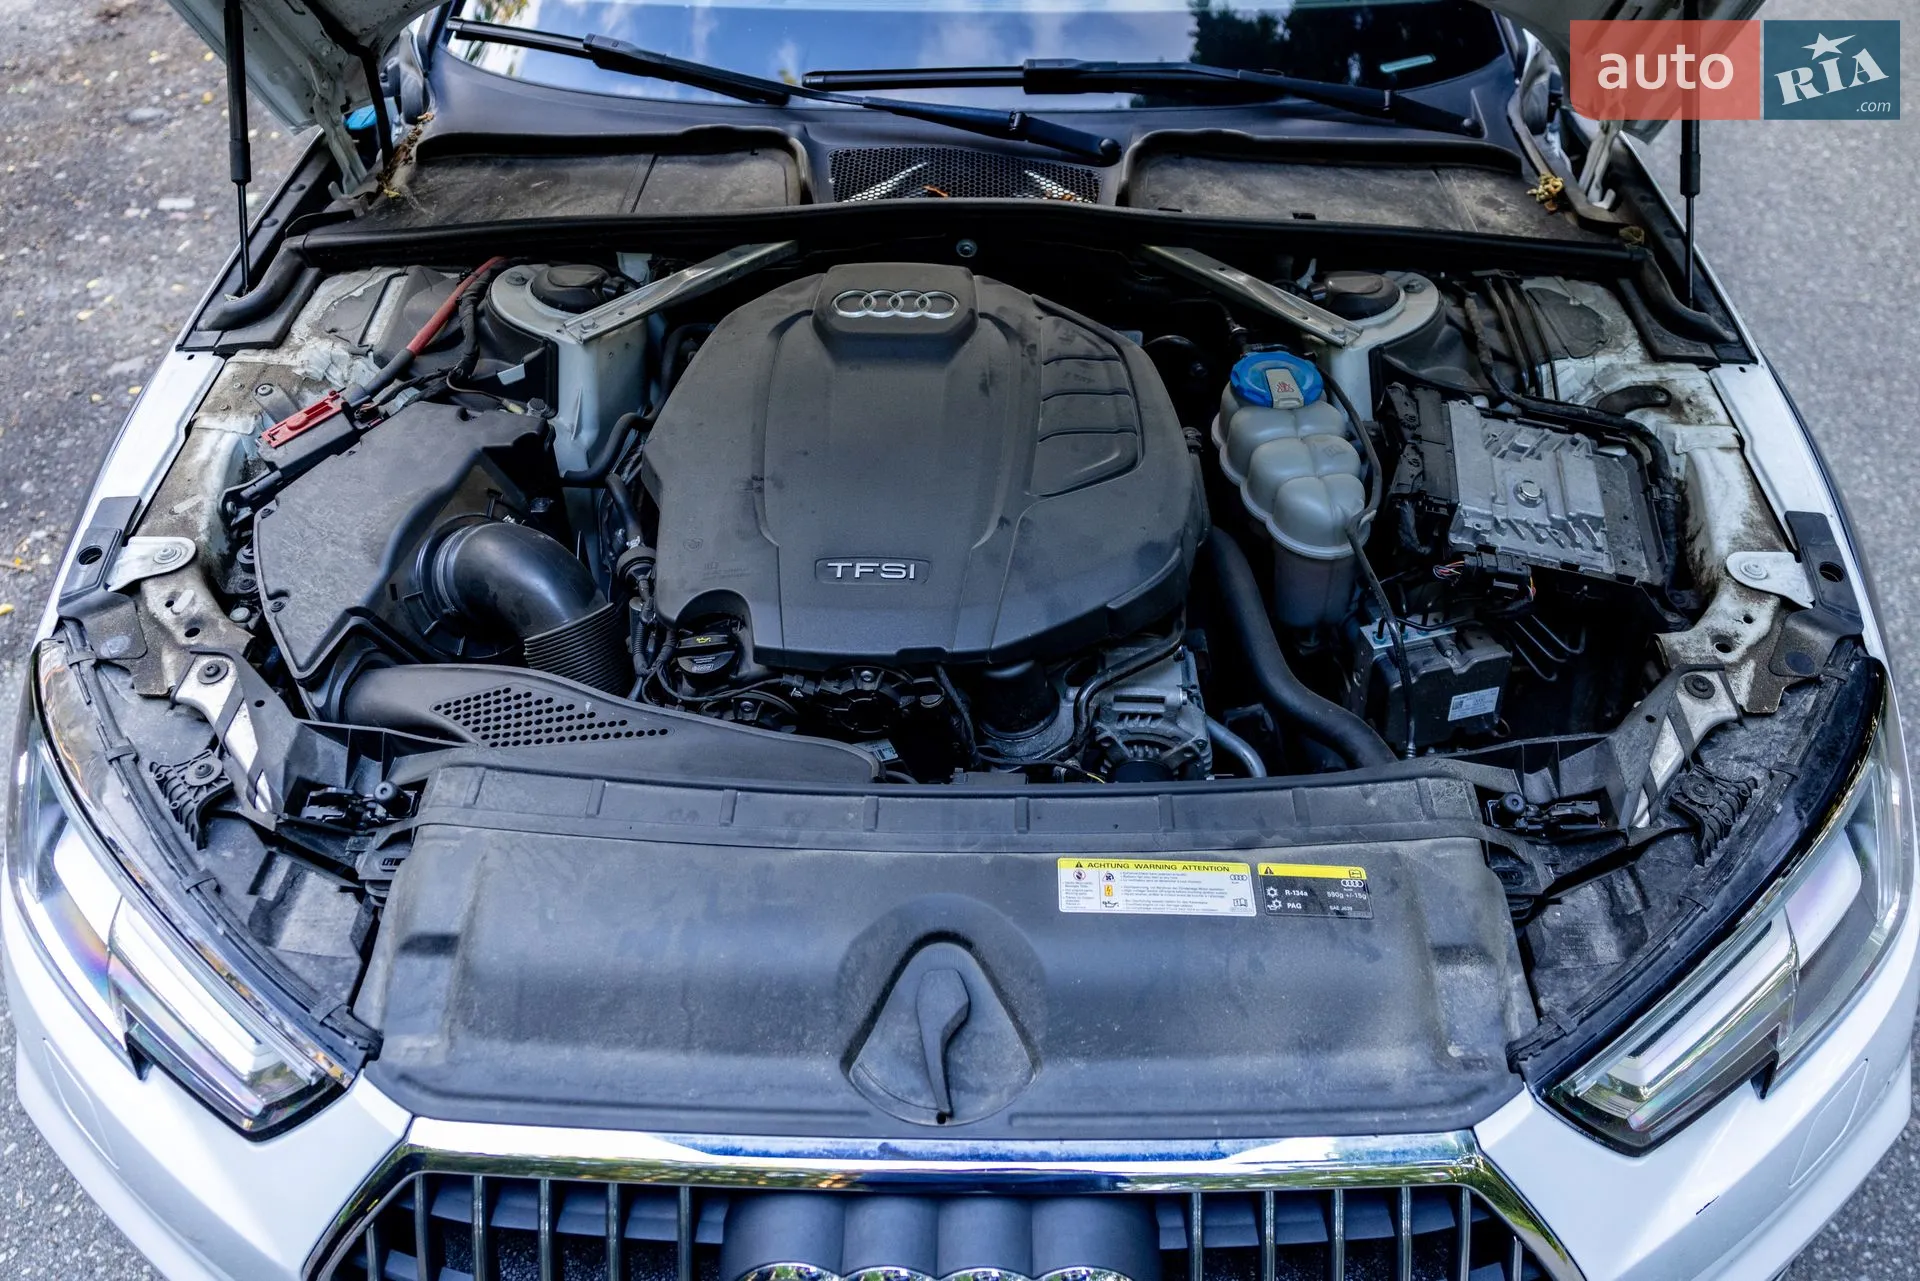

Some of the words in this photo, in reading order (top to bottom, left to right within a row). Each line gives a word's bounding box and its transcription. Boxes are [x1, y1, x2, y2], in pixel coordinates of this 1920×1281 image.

[827, 562, 915, 580] TFSI
[1087, 862, 1130, 870] ACHTUNG
[1134, 863, 1177, 871] WARNING
[1181, 864, 1230, 872] ATTENTION
[1284, 889, 1308, 897] R-134a
